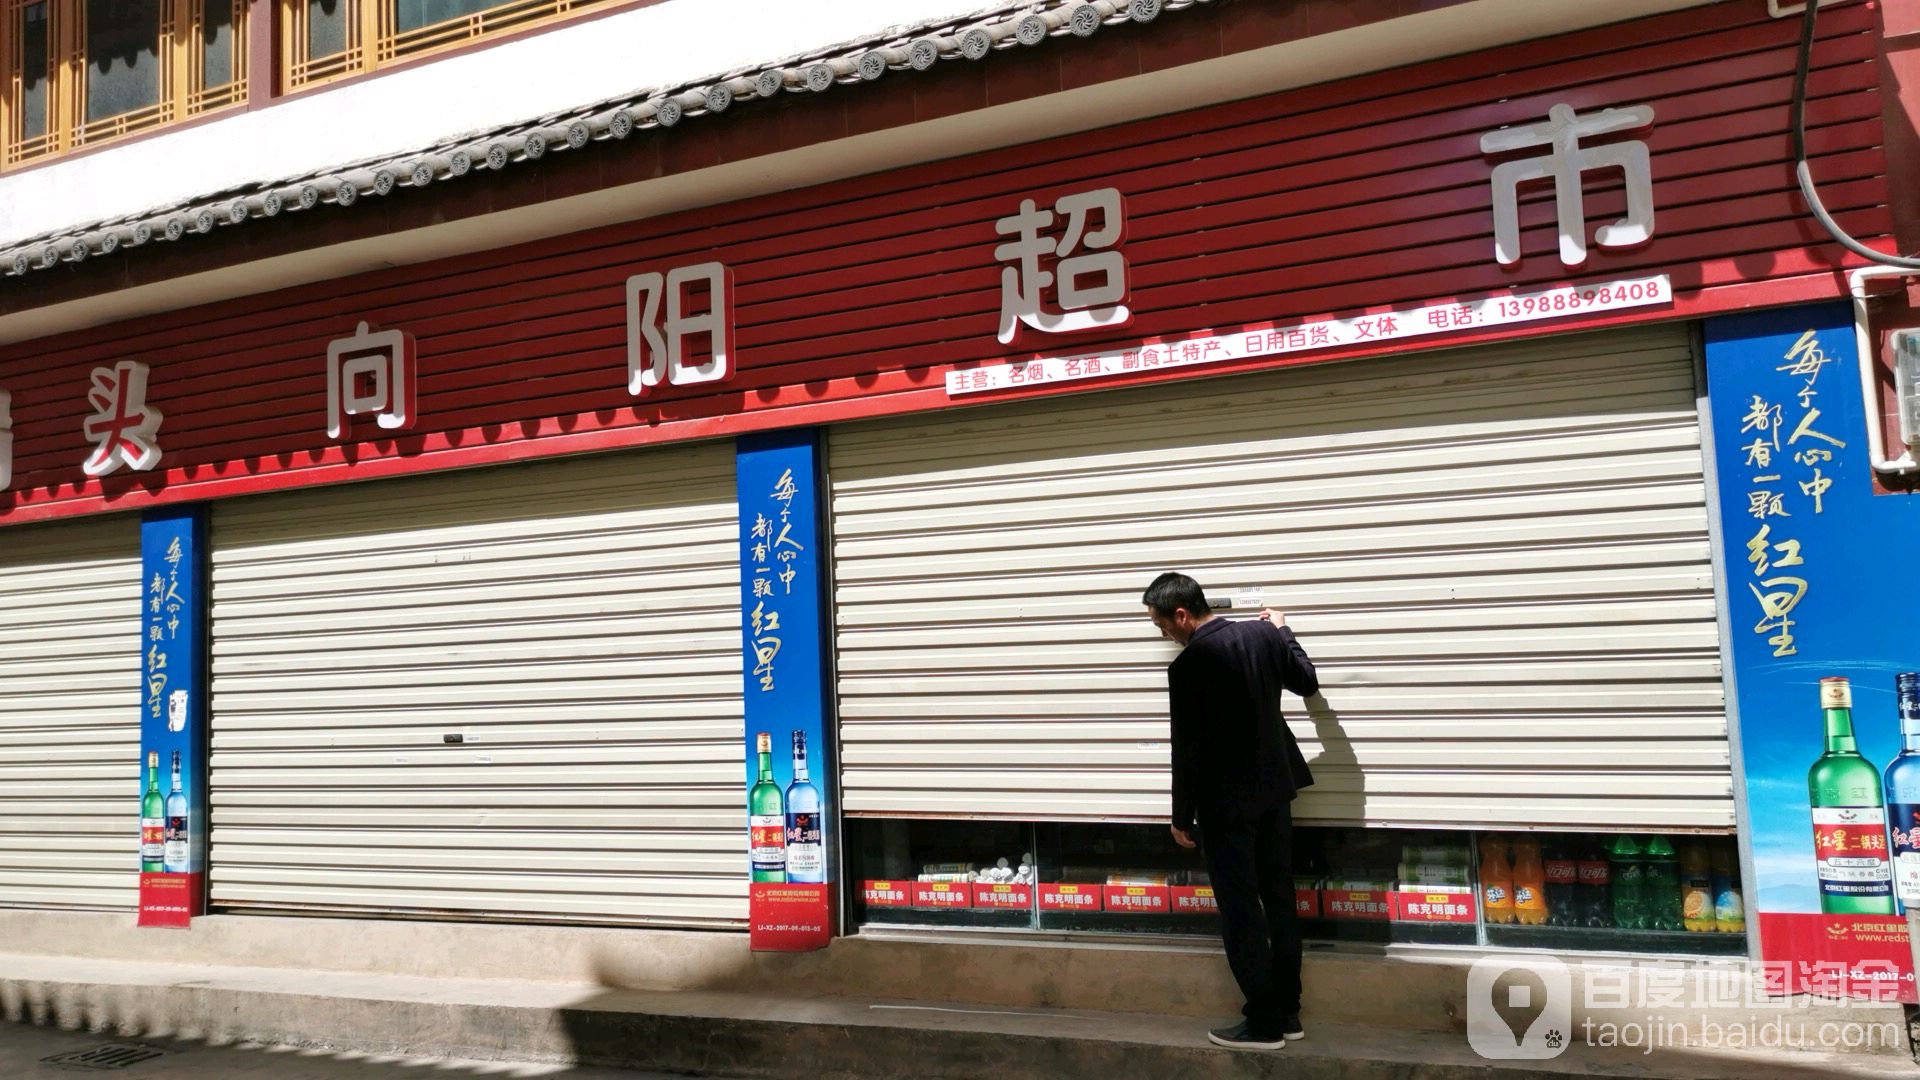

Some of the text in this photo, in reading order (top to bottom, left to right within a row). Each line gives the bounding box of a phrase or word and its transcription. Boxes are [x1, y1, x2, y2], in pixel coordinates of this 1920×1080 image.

[1776, 328, 1846, 514] 每个人心中
[770, 468, 804, 595] 每个人心中
[919, 891, 964, 902] 陈克明面条
[979, 892, 1027, 903] 陈克明面条
[1044, 893, 1093, 905] 陈克明面条
[1111, 895, 1162, 907] 陈克明面条
[1331, 901, 1390, 913] 陈克明面条
[1407, 903, 1469, 915] 陈克明面条
[1832, 969, 1916, 982] LJ-XZ-2017-0
